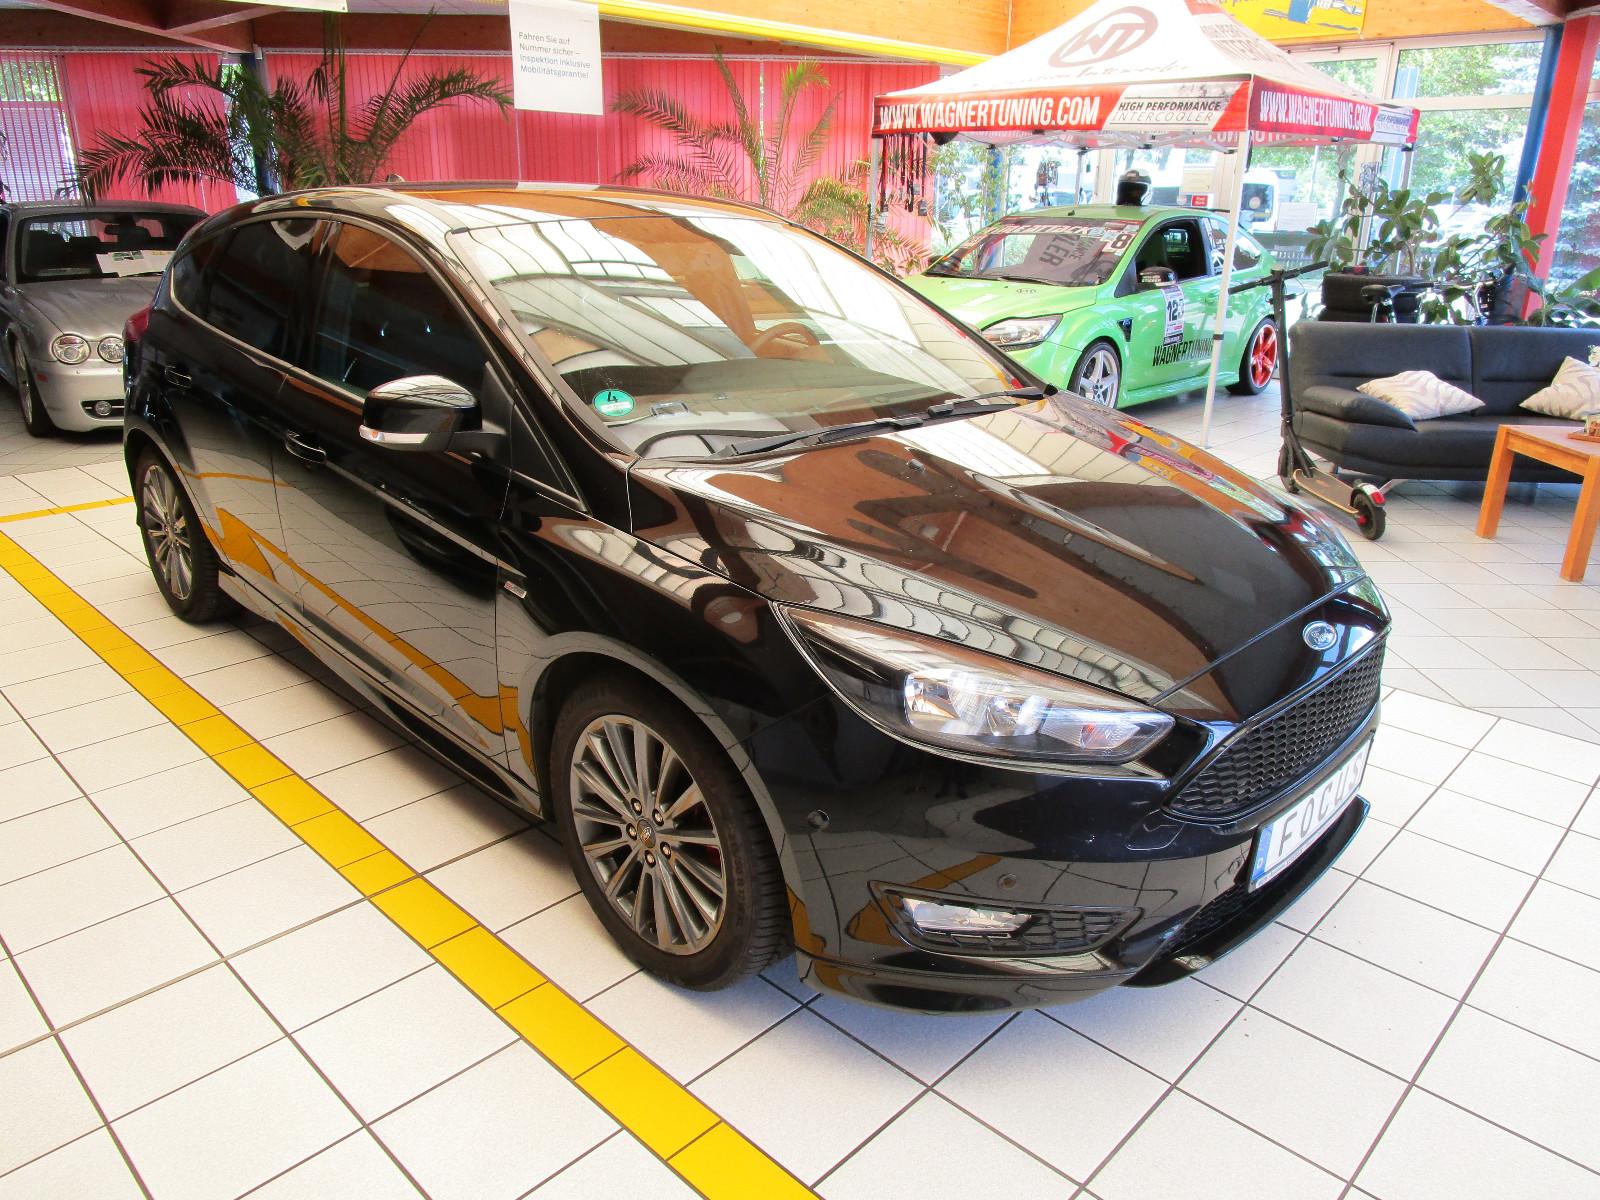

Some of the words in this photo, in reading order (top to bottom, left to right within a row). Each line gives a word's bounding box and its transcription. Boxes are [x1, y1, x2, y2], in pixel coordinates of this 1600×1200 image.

[518, 31, 544, 42] Fahren
[546, 35, 557, 44] Sie
[558, 37, 571, 45] auf
[519, 43, 551, 53] Nummer
[552, 46, 574, 56] sicher
[559, 59, 591, 69] inklusive
[520, 65, 589, 79] Mobilitätsgarantie!
[1118, 101, 1144, 111] HIGH
[1145, 101, 1222, 111] PERFORMANCE
[1260, 90, 1372, 132] WWW.WAGNERTUNING.COM
[880, 97, 1100, 130] WWW.WAGNERTUNING.COM
[1112, 111, 1213, 121] INTERCOOLER
[607, 391, 618, 402] 4
[1278, 752, 1364, 857] FOCUS
